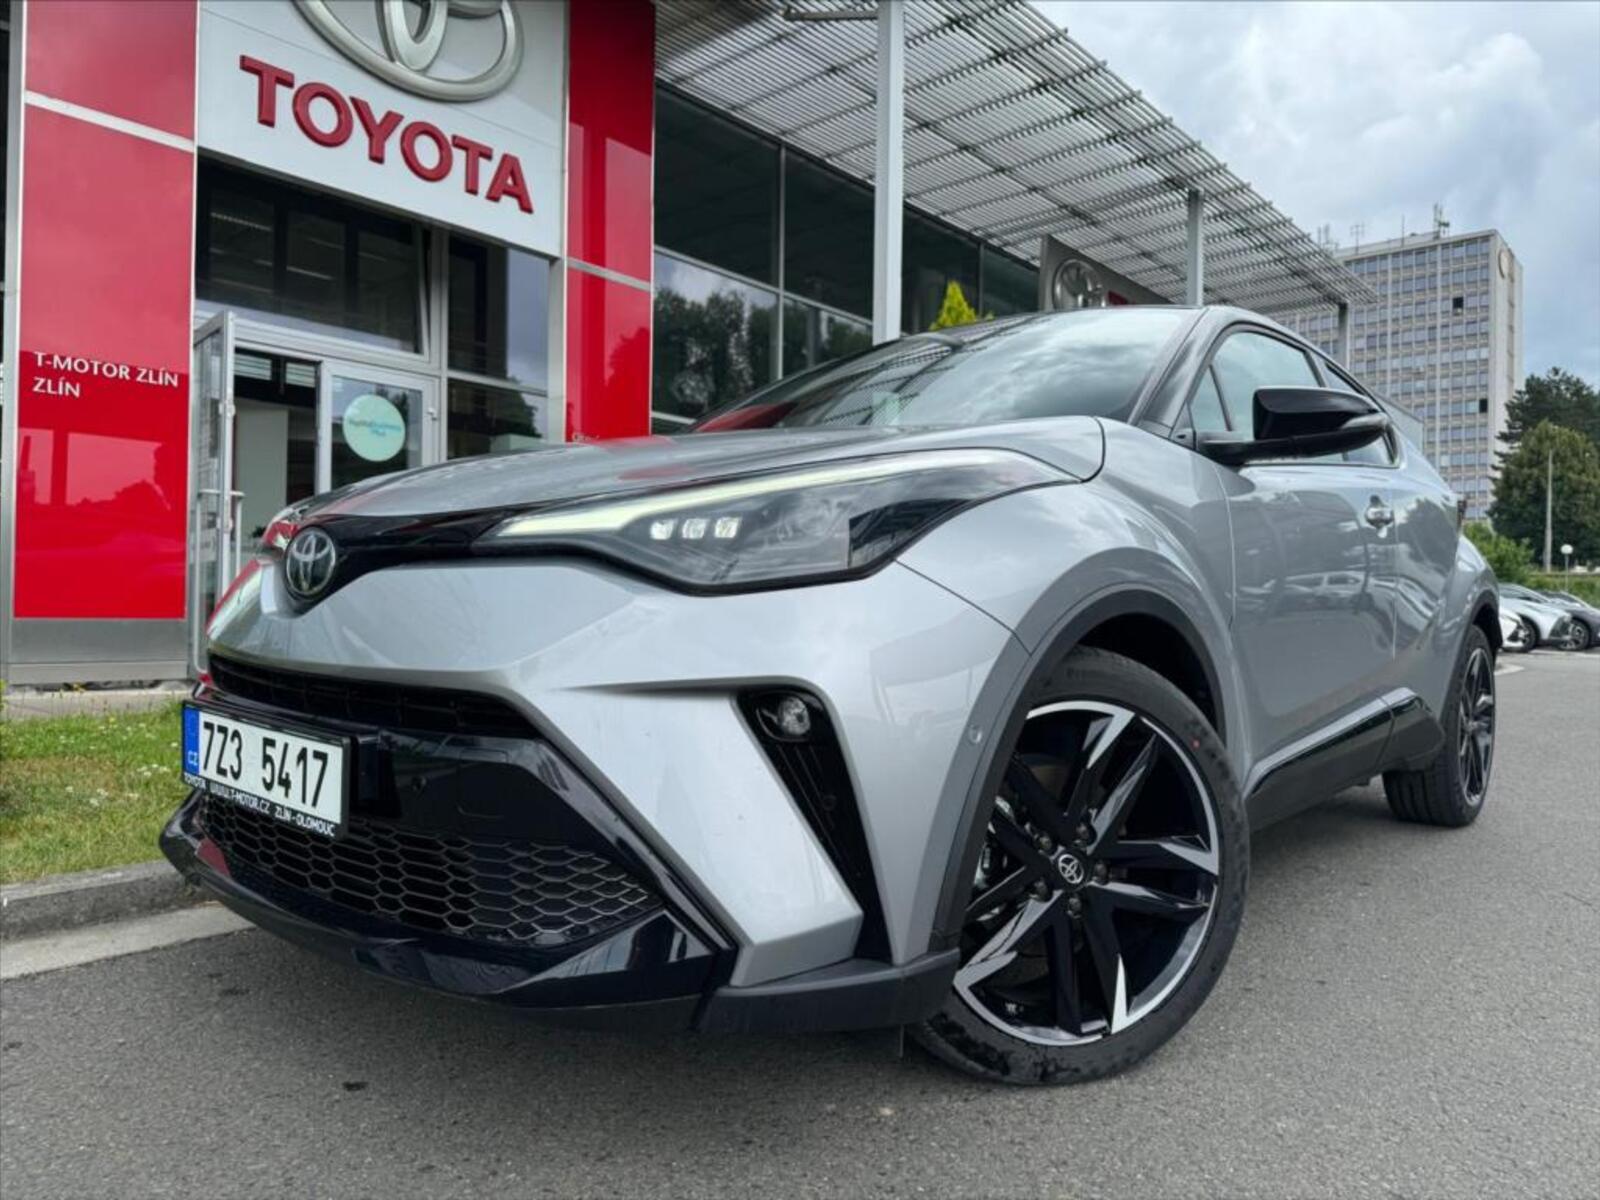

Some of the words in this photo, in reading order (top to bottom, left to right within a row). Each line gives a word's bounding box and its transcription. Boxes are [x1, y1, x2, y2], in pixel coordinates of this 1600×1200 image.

[239, 54, 534, 215] TOYOTA
[32, 375, 81, 399] ZLÍN
[34, 351, 131, 381] T-MOTOR
[136, 367, 179, 388] ZLÍN
[187, 750, 198, 766] CZ
[203, 721, 243, 781] 7Z3
[262, 736, 328, 809] 5417
